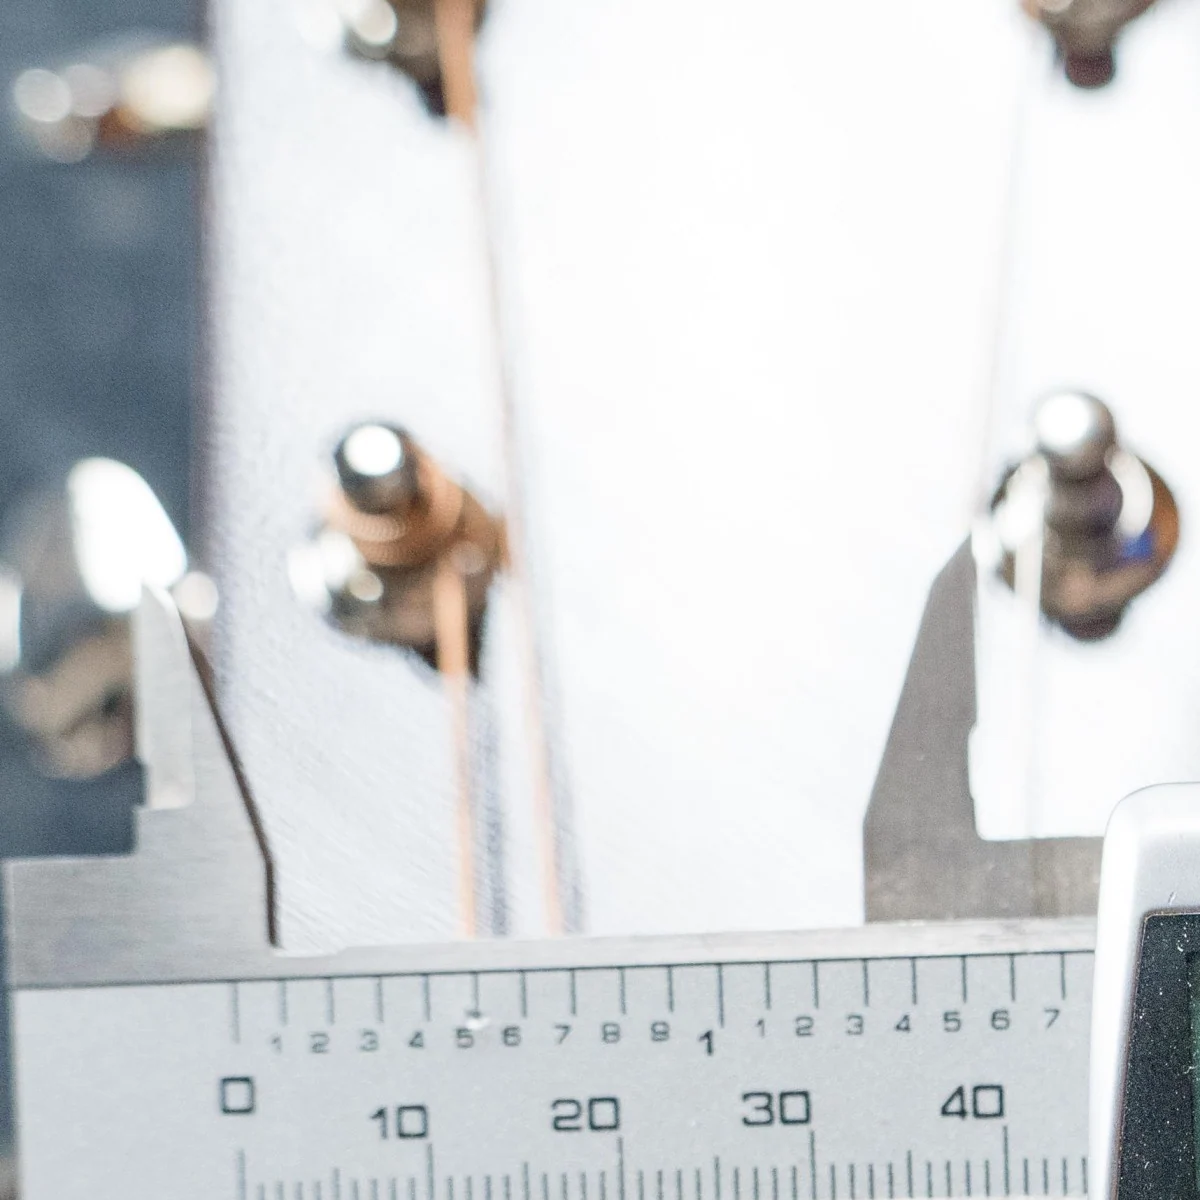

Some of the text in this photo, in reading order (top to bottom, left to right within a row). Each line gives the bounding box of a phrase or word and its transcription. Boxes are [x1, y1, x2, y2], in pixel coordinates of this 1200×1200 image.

[269, 1008, 1061, 1056] 1 2 3 4 5 6 7 8 9 1 1 2 3 4 5 6 7
[219, 1076, 1006, 1140] 0 10 20 30 40
